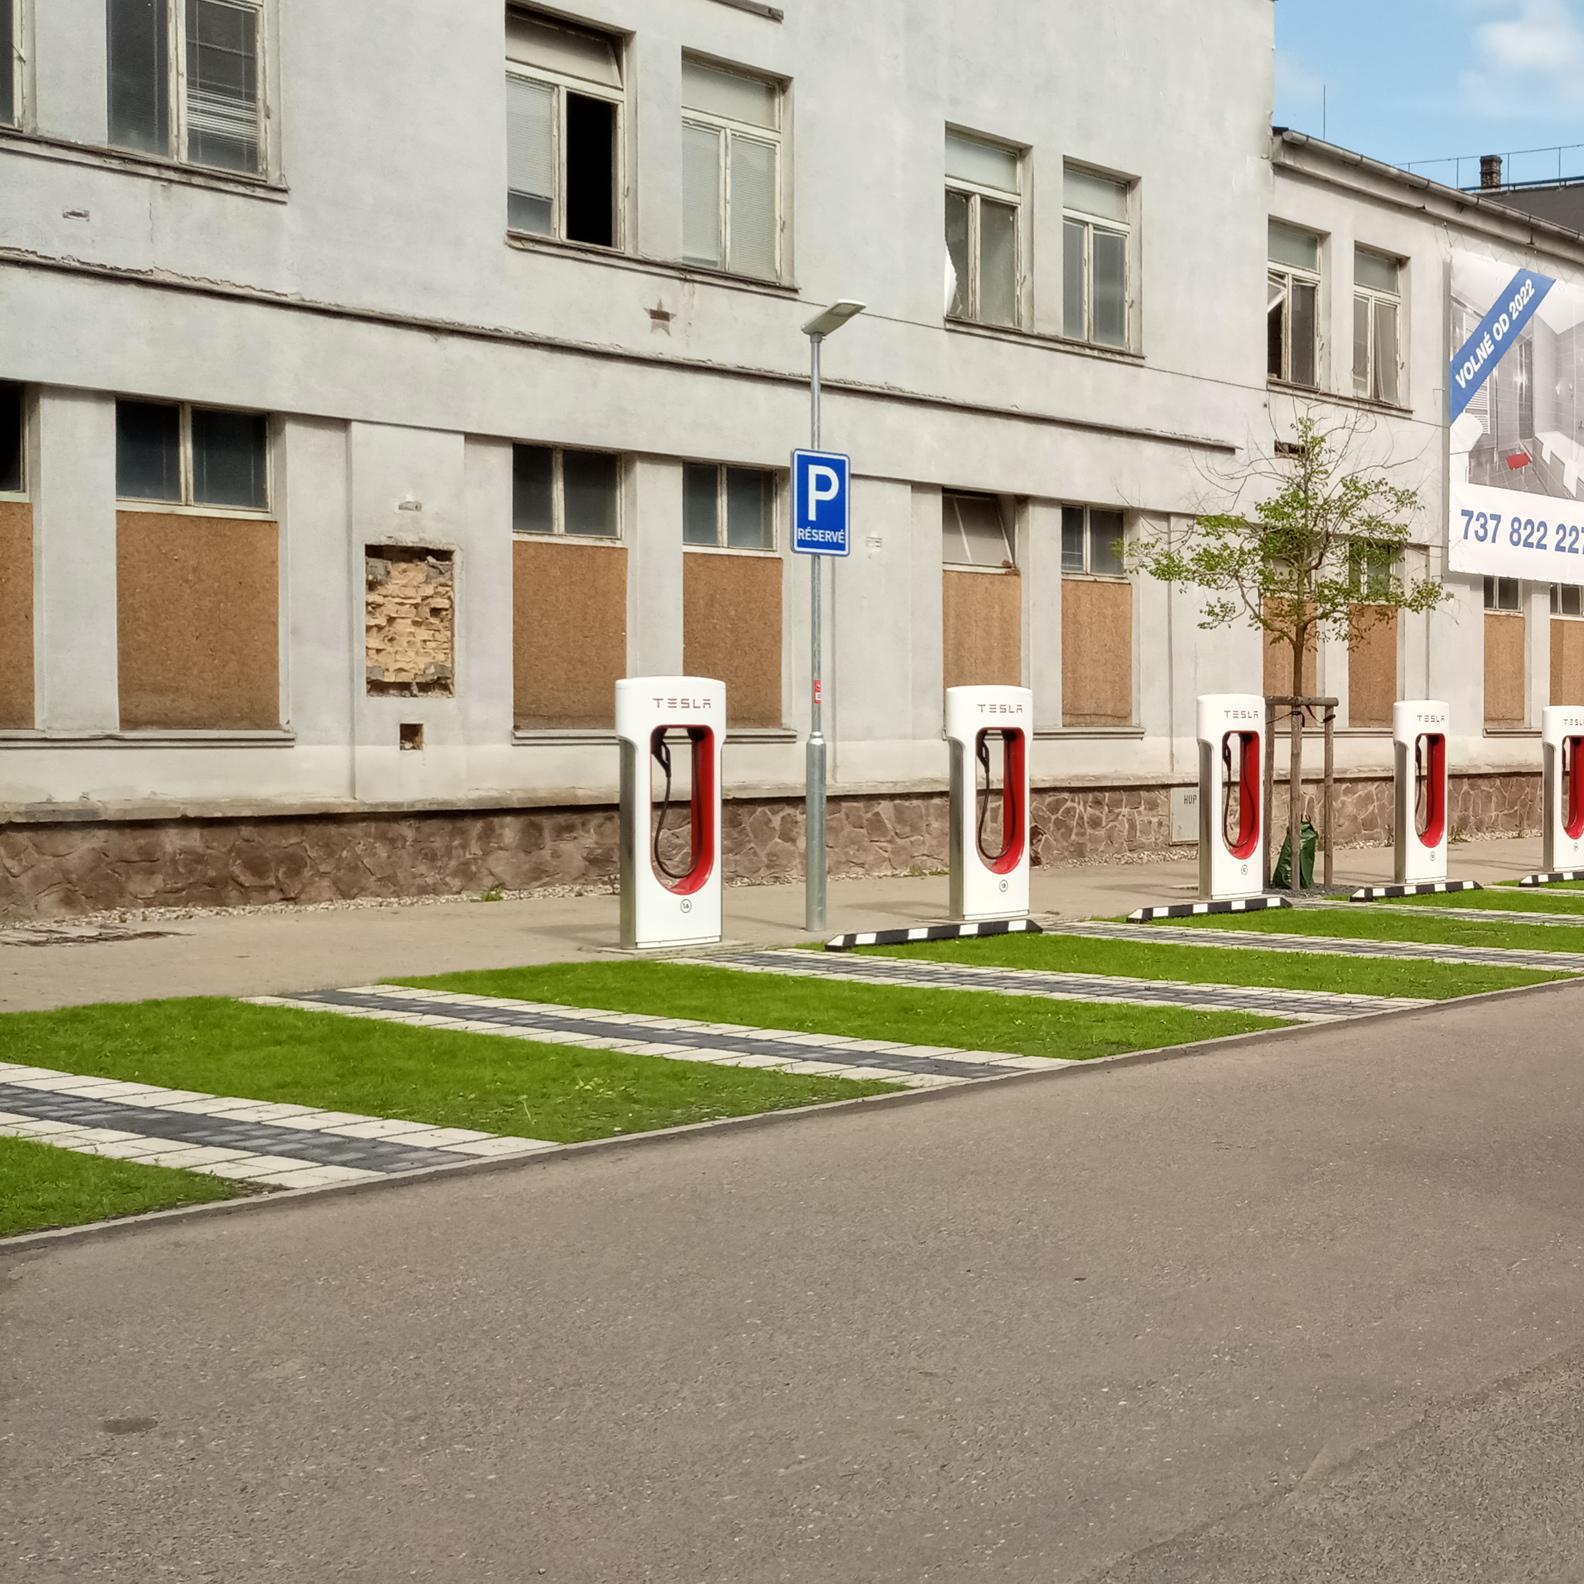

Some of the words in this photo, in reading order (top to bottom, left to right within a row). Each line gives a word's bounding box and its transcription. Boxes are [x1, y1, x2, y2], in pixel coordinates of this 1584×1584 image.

[1456, 331, 1495, 388] VOLNÉ
[1493, 313, 1510, 341] OD
[1509, 279, 1535, 320] 2022
[808, 464, 839, 521] P
[1461, 509, 1502, 544] 737
[1509, 517, 1548, 550] 822
[797, 527, 845, 544] RÉSERVÉ
[652, 698, 711, 709] TESLA
[977, 704, 1023, 714] TESLA
[1224, 710, 1259, 719] TESLA
[1417, 715, 1445, 723] TESLA
[1183, 794, 1198, 805] HUP
